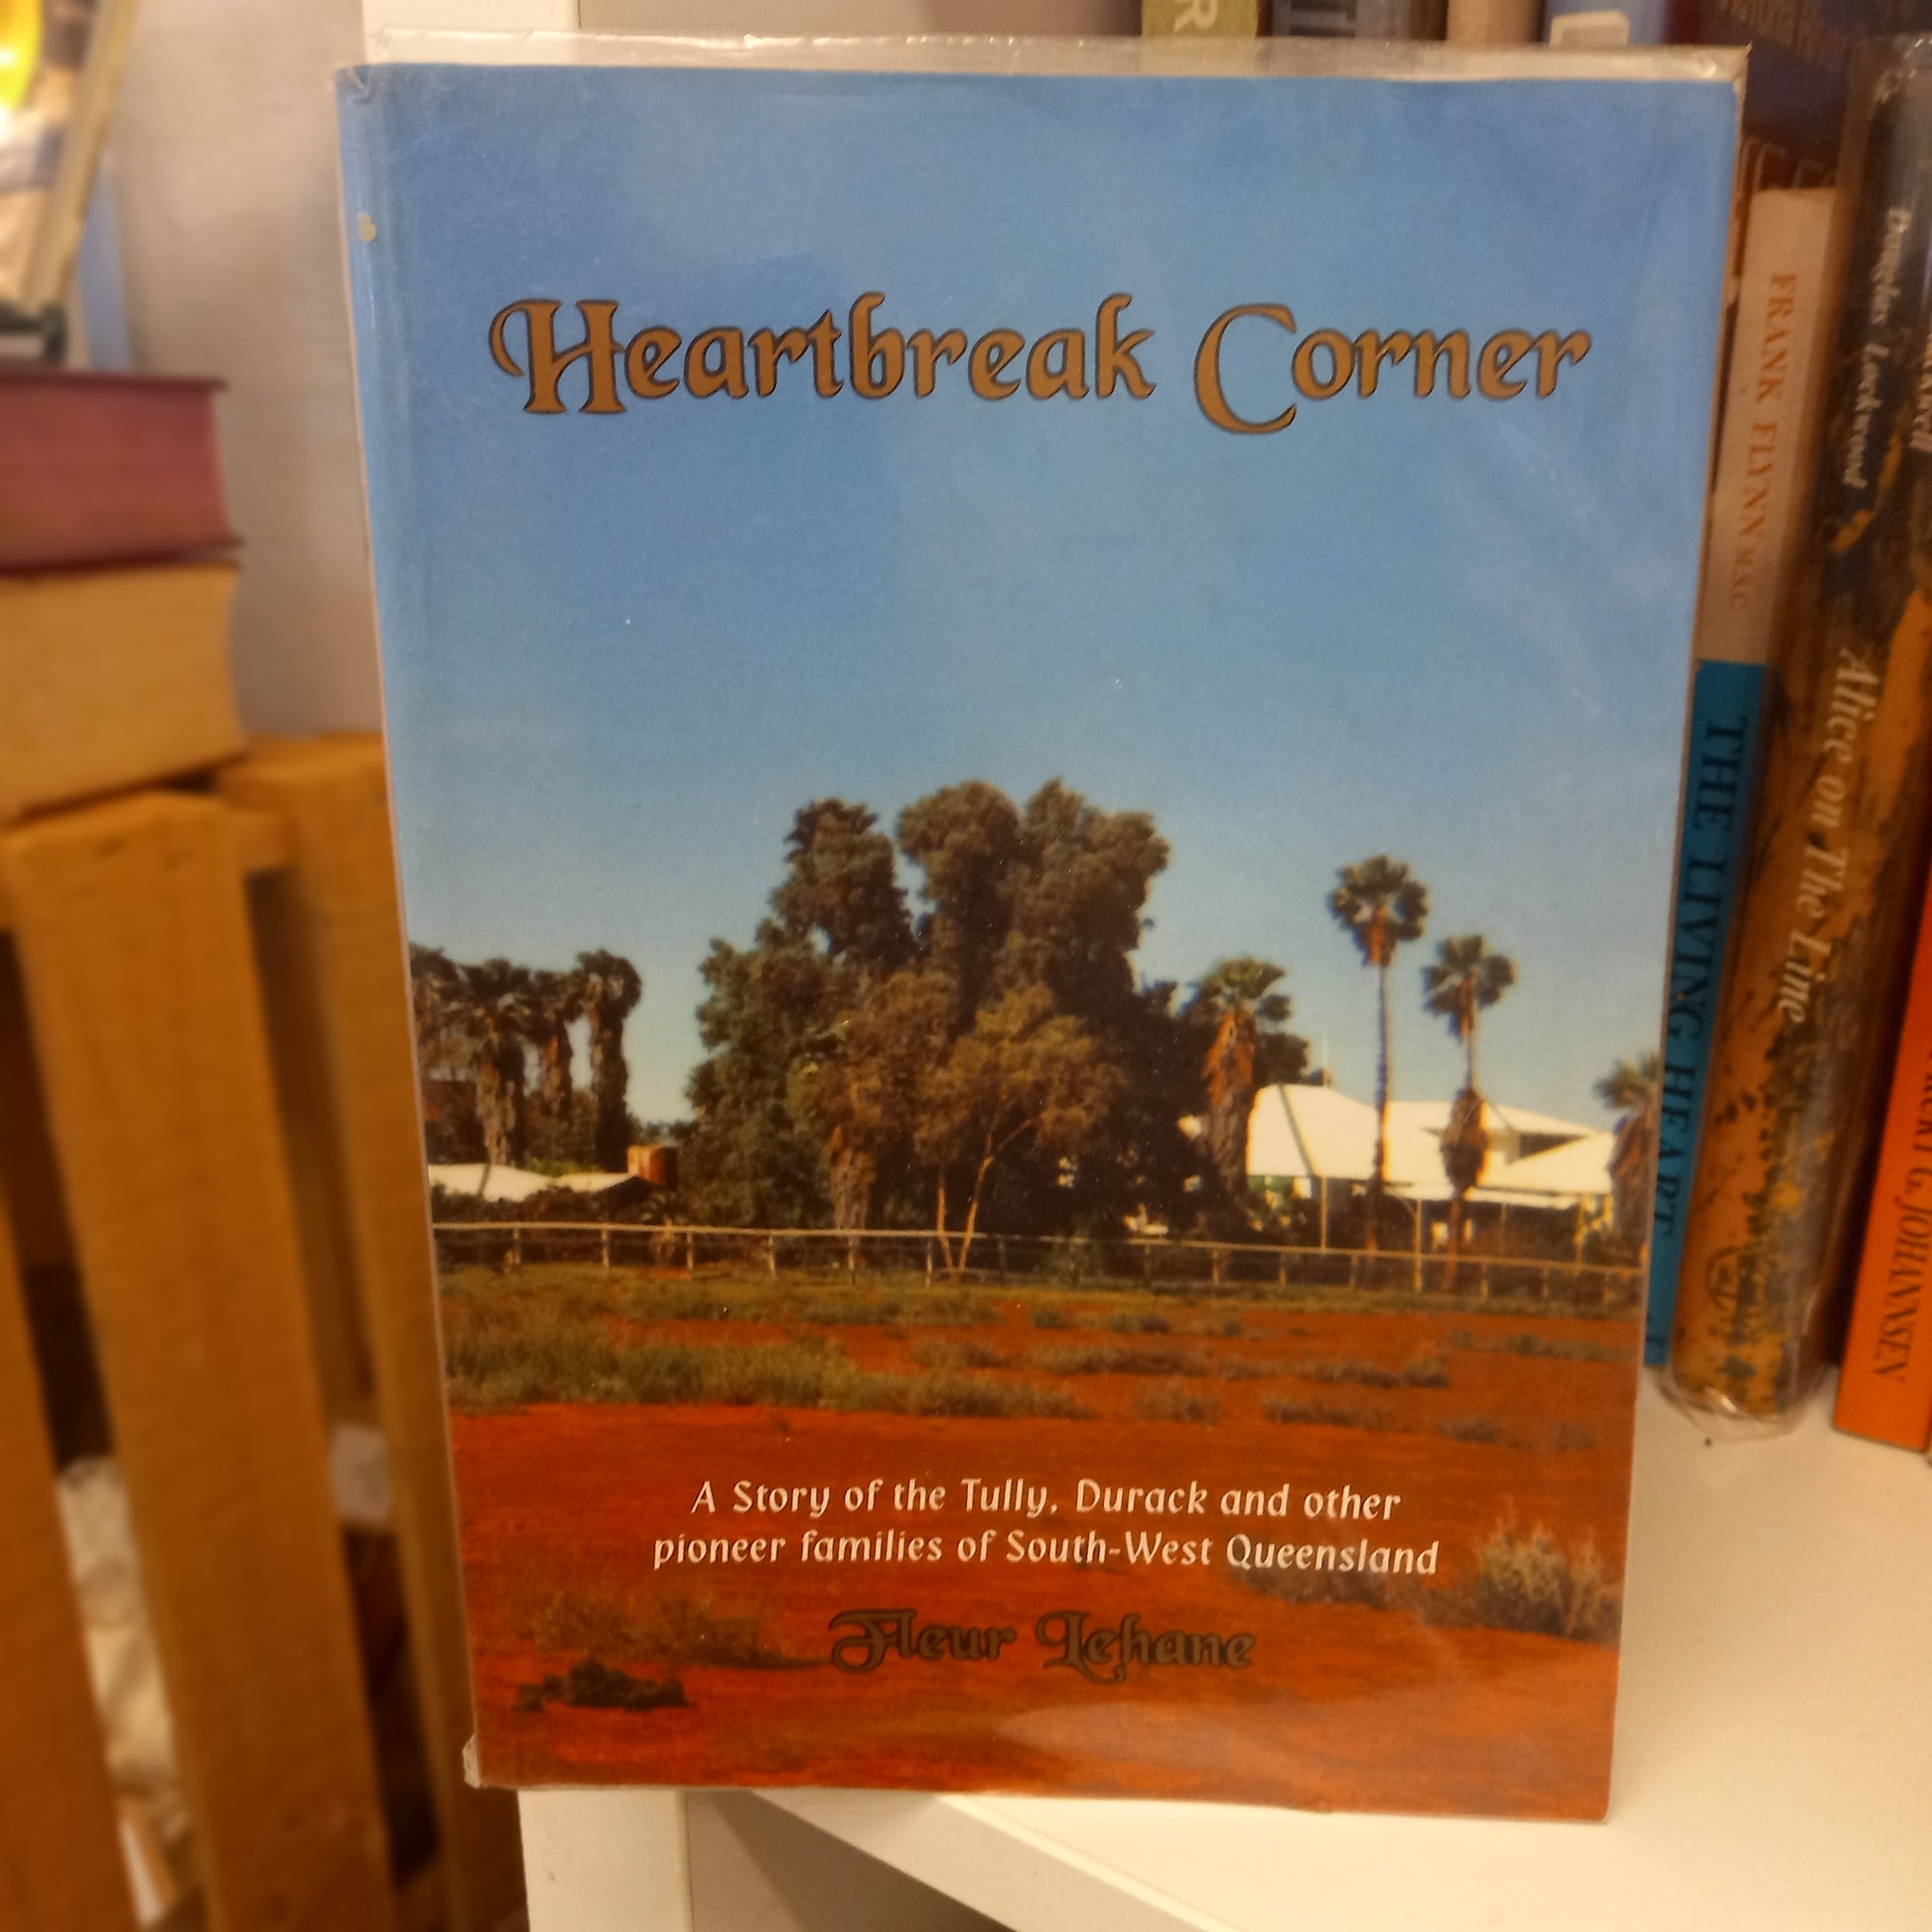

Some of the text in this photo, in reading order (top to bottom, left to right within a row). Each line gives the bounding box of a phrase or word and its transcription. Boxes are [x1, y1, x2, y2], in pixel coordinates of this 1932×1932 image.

[489, 292, 1590, 434] Heartbreak Corner
[1756, 272, 1798, 404] FRANK
[1739, 423, 1778, 537] FLYNN
[1694, 713, 1747, 832] THE
[1776, 647, 1879, 1025] Alice on The Line
[1669, 857, 1726, 1038] LIVING
[1872, 1194, 1932, 1384] JOHANNSEN
[653, 1529, 1441, 1575] pioneer families of South-West Queensland
[691, 1481, 716, 1513] A
[733, 1479, 831, 1519] Story
[844, 1478, 884, 1513] of
[895, 1478, 946, 1512] the
[1076, 1477, 1208, 1515] Durack
[1219, 1482, 1291, 1518] and
[1303, 1484, 1402, 1521] other
[827, 1607, 1257, 1685] Fleur Lehane
